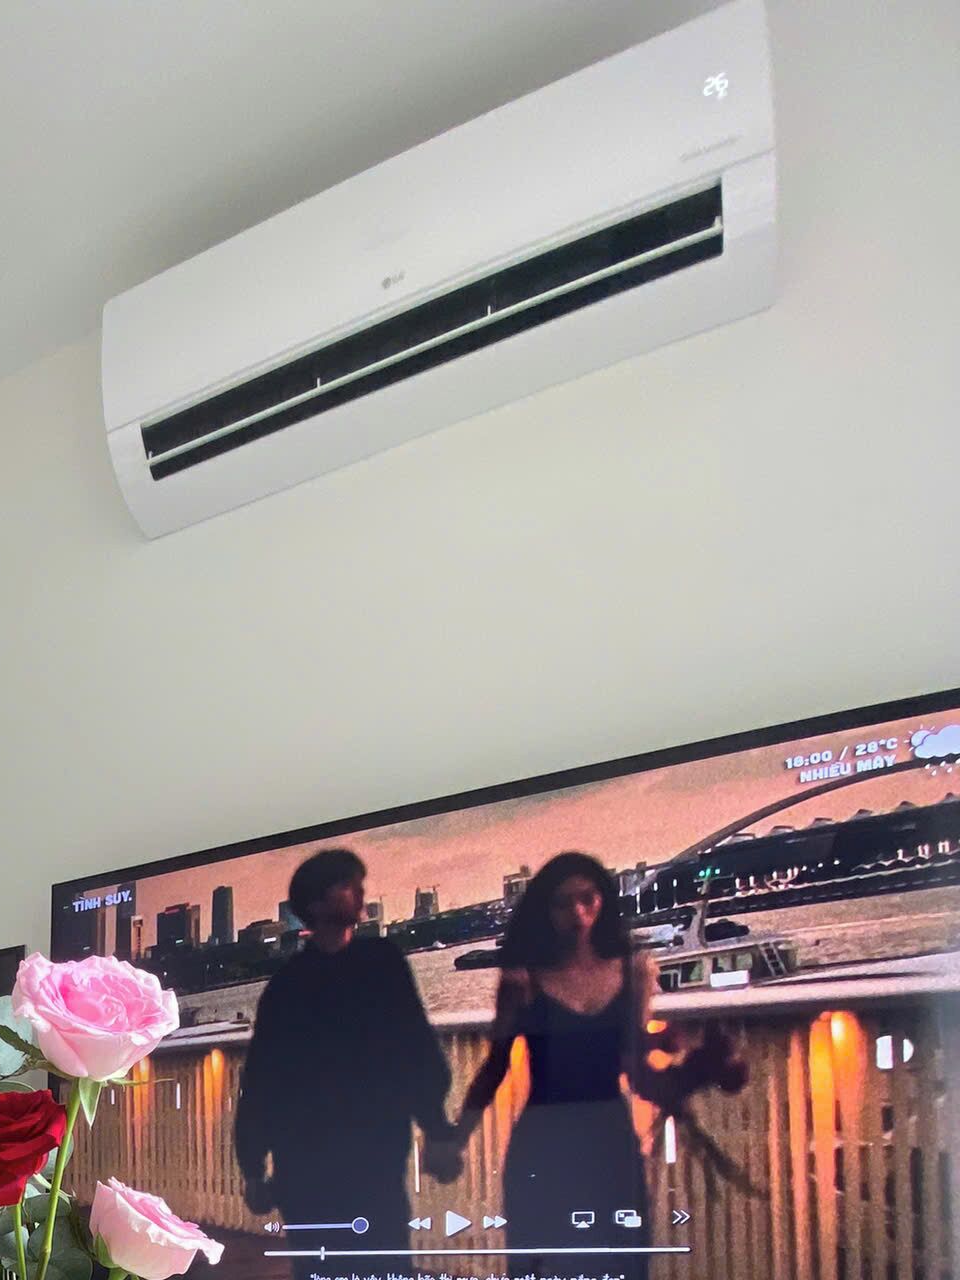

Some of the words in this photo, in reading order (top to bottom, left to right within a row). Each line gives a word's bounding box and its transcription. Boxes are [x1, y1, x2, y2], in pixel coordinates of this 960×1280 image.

[785, 750, 833, 770] 18:00
[72, 896, 101, 912] TÌNH
[105, 889, 132, 906] SUY.
